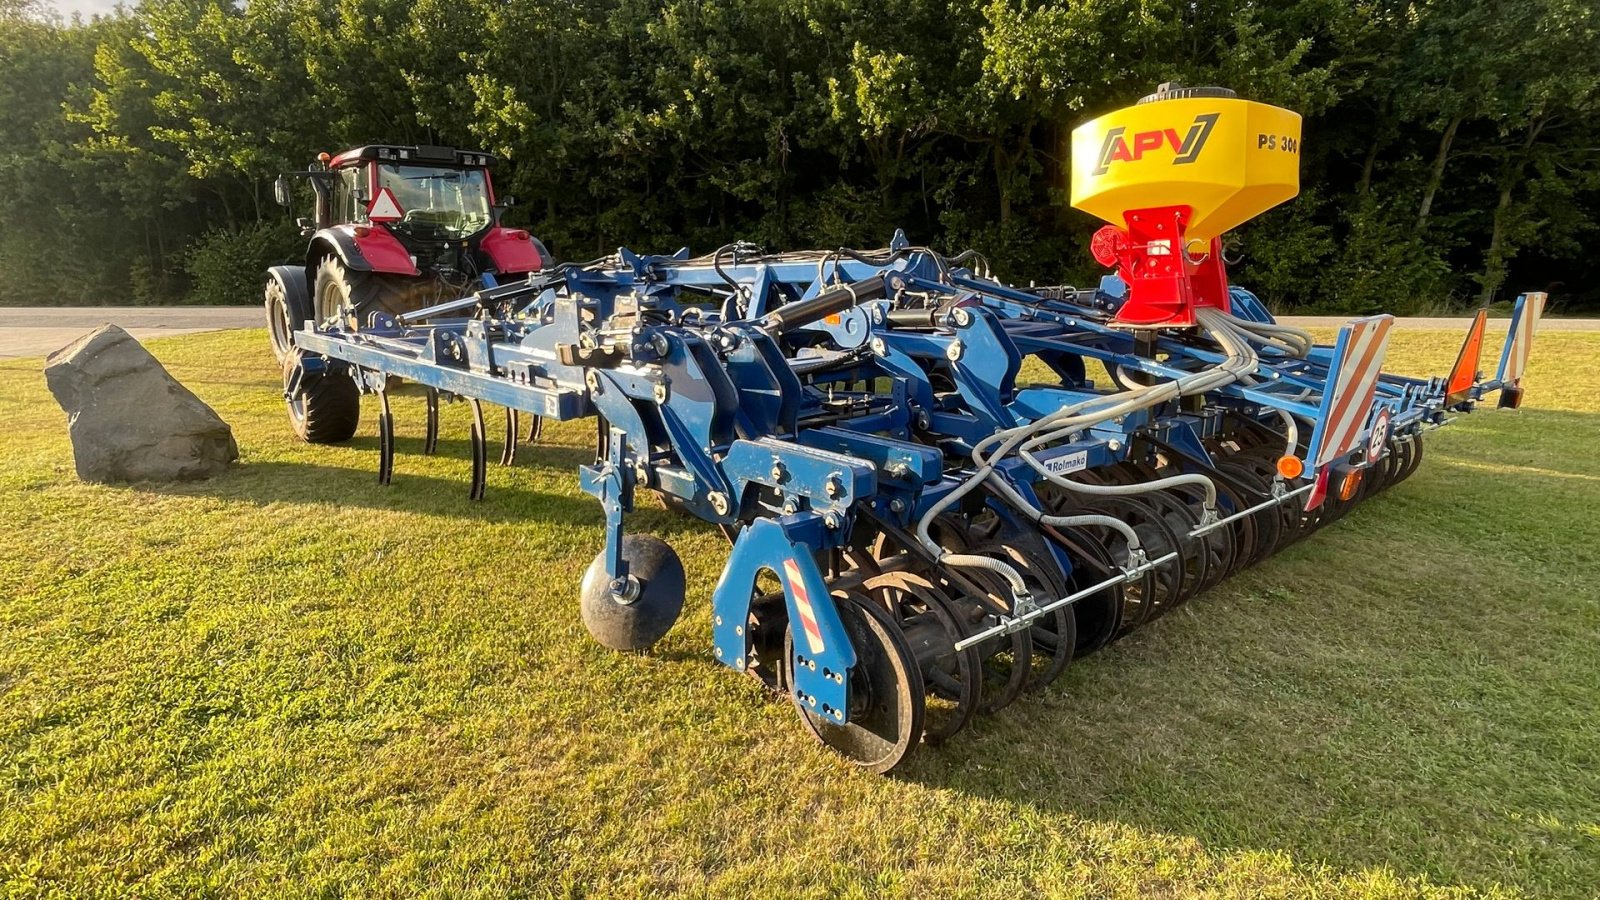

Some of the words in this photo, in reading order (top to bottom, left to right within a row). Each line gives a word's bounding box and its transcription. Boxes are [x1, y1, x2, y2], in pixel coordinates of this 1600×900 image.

[1102, 124, 1203, 167] APV
[1258, 134, 1276, 150] PS
[1281, 136, 1297, 154] 300
[1372, 425, 1385, 448] 25
[1053, 455, 1086, 473] Rolmako
